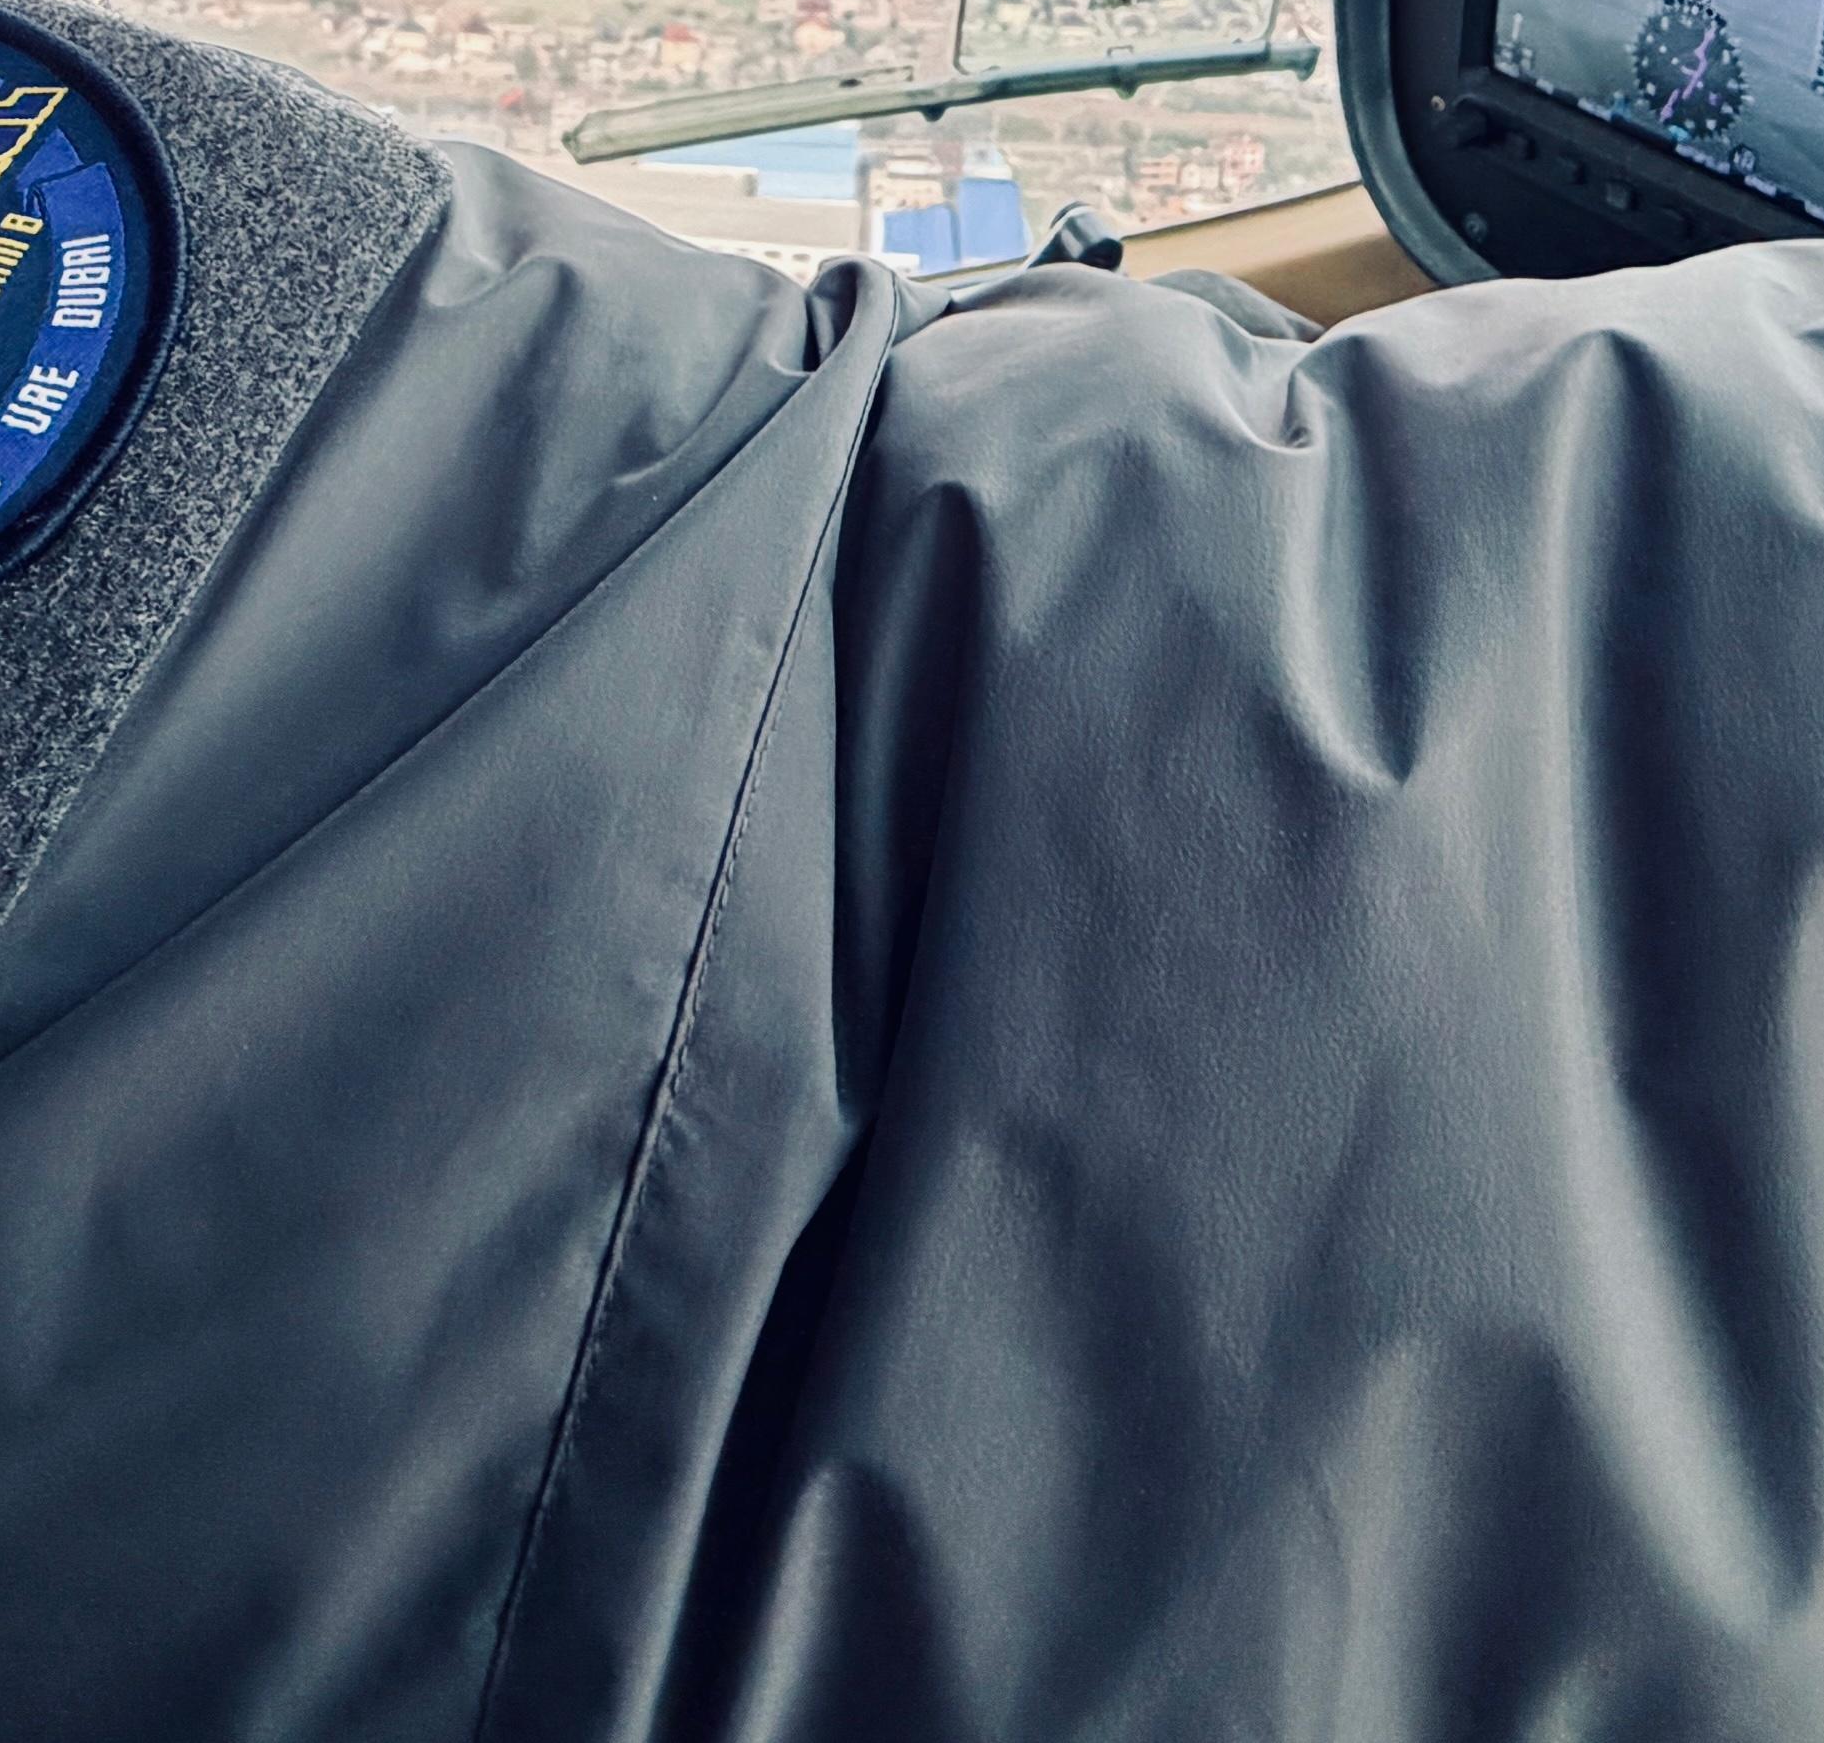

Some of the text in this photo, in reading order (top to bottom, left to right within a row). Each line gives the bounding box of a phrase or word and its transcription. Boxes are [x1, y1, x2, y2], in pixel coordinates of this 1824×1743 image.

[0, 212, 45, 236] B
[0, 364, 80, 436] UAE
[51, 233, 113, 329] DUBAI
